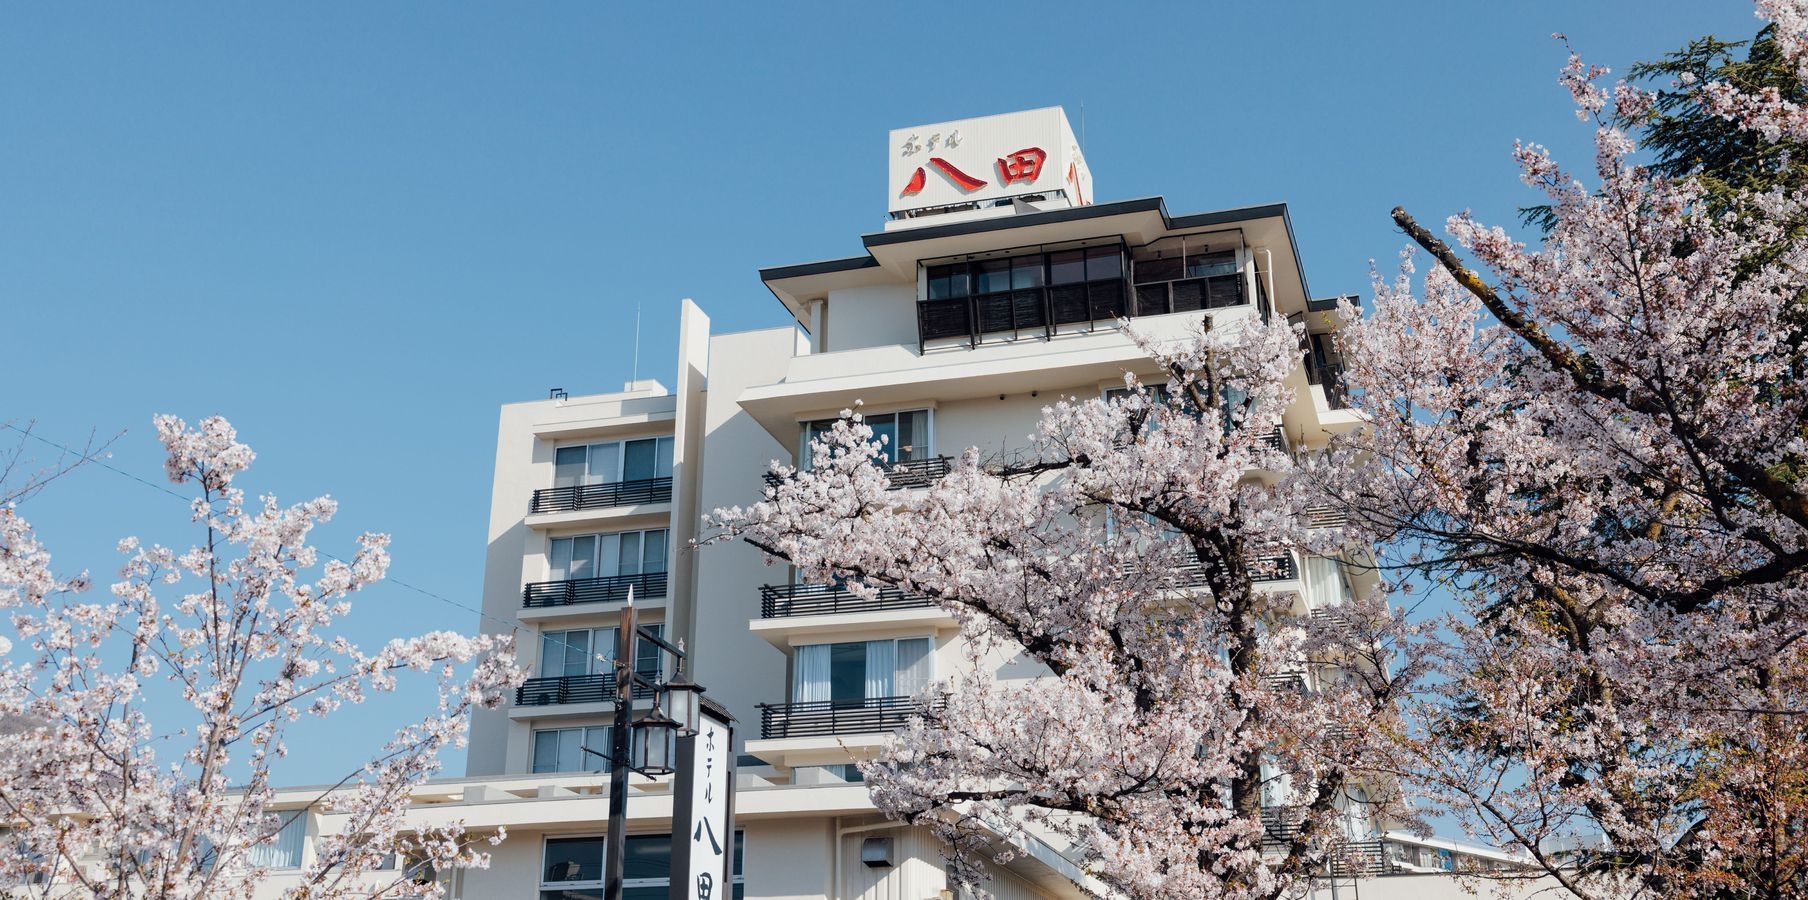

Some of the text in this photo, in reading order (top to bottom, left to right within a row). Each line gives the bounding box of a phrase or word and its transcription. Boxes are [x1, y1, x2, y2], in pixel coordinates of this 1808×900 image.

[901, 129, 963, 157] ホテル
[900, 147, 1047, 196] 八田
